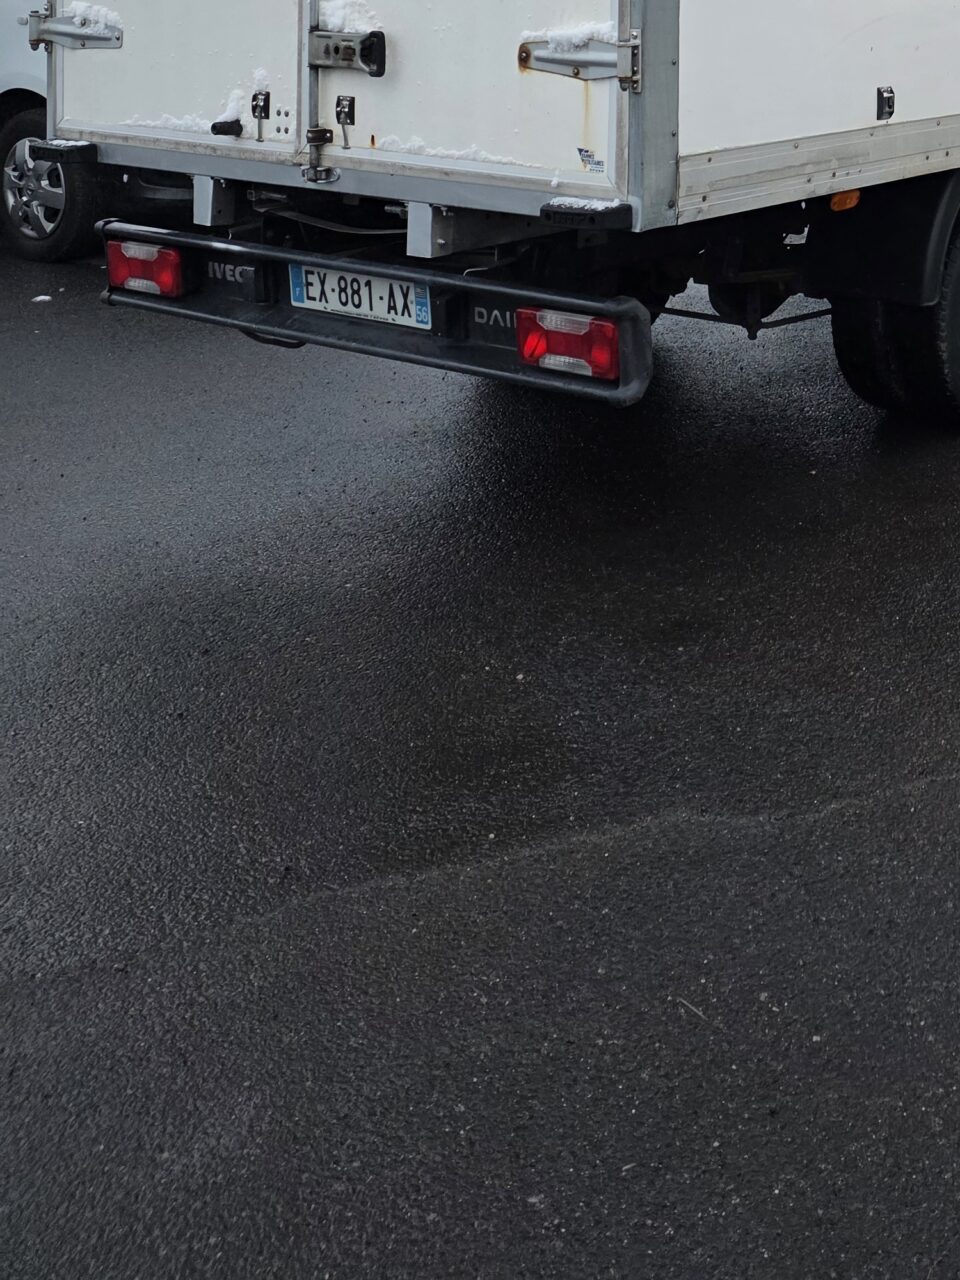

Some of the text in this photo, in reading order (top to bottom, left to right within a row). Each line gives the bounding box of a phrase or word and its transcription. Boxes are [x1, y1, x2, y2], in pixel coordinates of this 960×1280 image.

[208, 261, 246, 283] IVEC
[304, 269, 412, 318] EX-881-AX
[415, 305, 428, 322] 56
